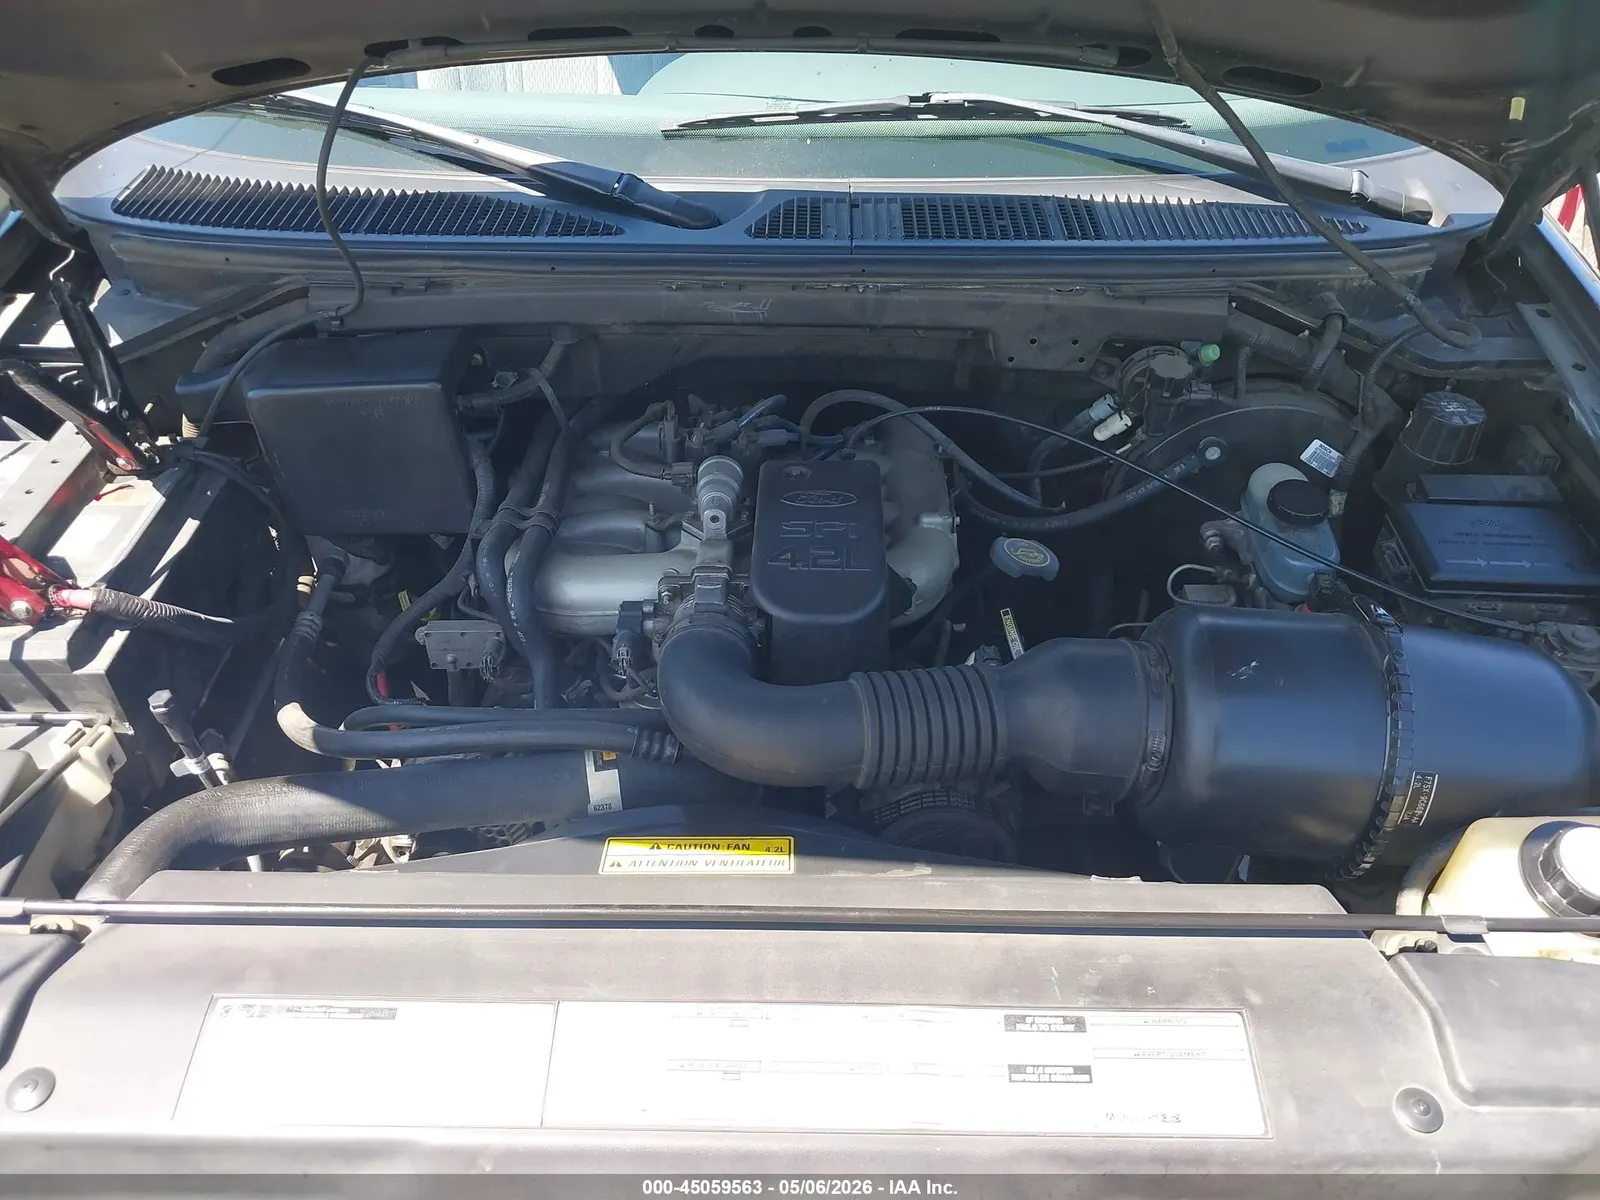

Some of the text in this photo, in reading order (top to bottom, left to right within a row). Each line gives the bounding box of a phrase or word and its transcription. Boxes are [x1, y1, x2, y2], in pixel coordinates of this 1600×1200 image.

[767, 546, 871, 570] 4.2L
[1003, 614, 1020, 653] ENGINE OIL
[1413, 775, 1422, 789] 4.2L
[727, 843, 750, 851] FAN
[628, 859, 786, 867] ATTENTION VENTILATEUR
